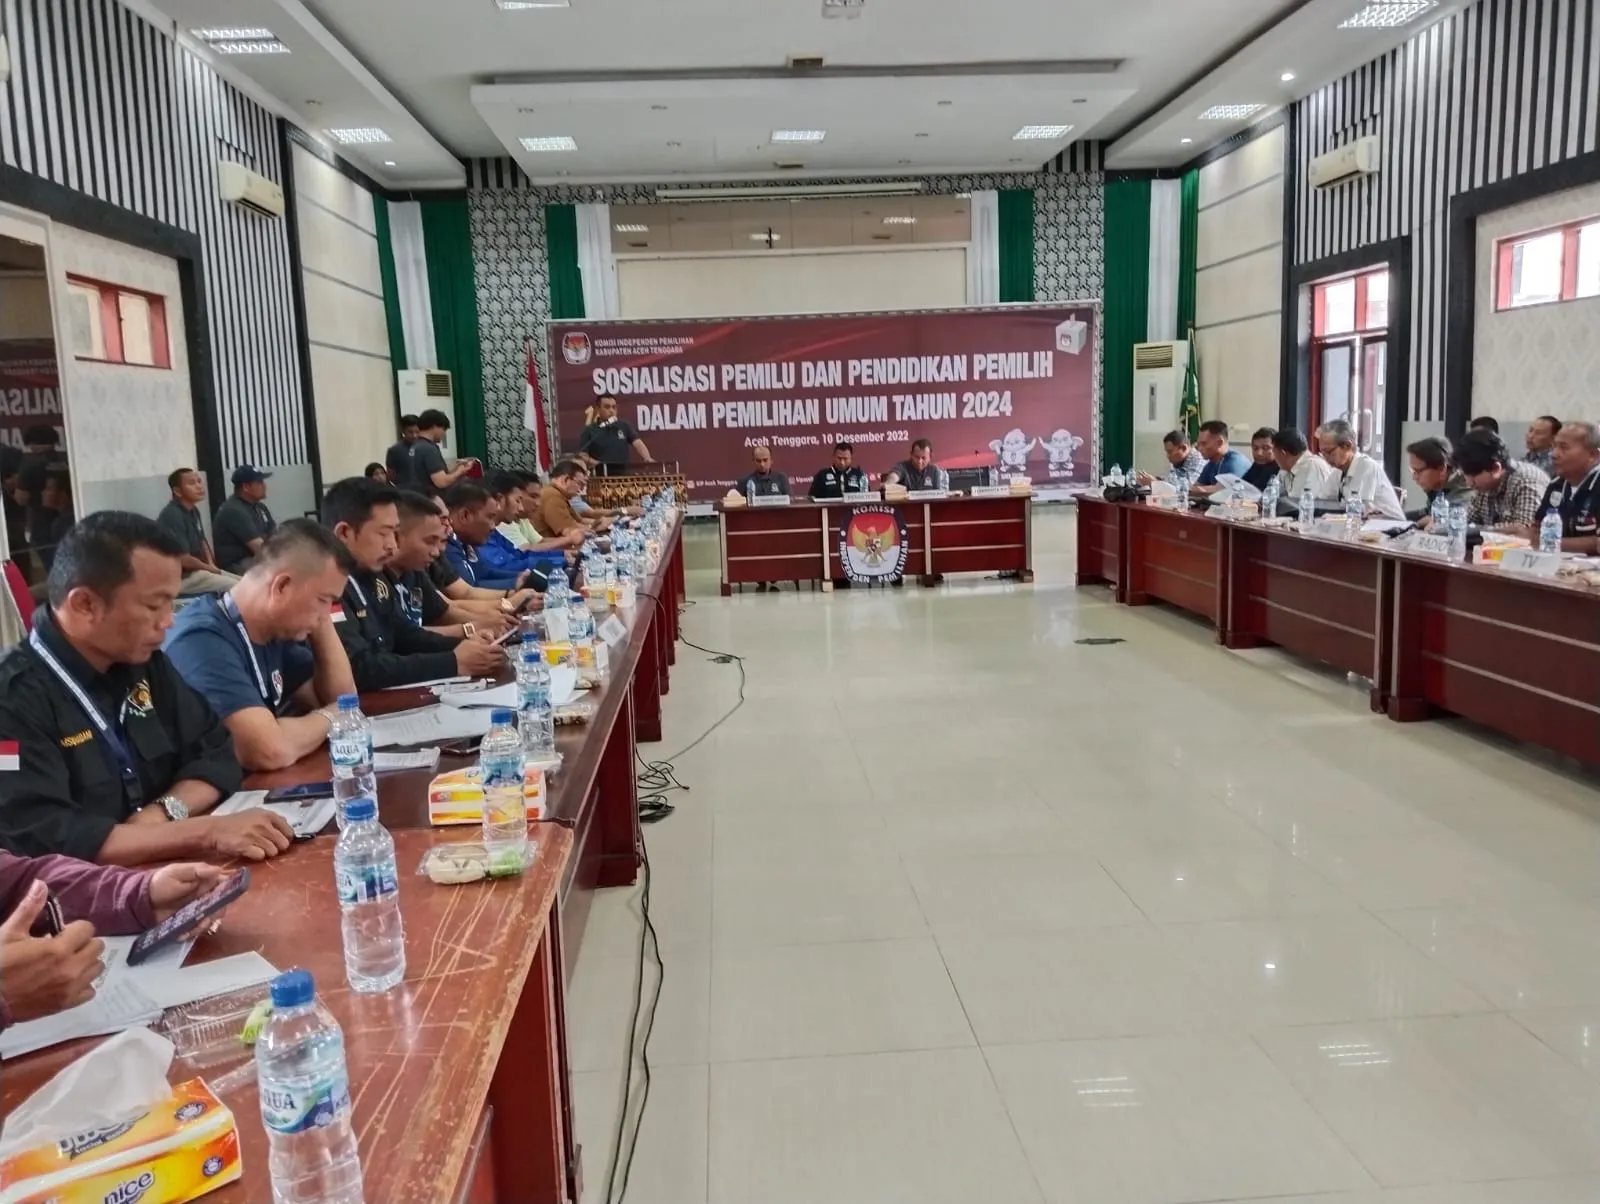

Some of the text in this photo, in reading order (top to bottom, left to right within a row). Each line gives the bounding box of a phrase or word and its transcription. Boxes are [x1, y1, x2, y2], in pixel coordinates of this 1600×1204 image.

[617, 337, 658, 346] INDEPENDEN
[660, 336, 694, 345] PEMILIHAN
[595, 346, 683, 355] KABUPATEN ACEH TENGGARA
[593, 351, 1053, 396] SOSIALISASI PEMILU DAN PENDIDIKAN PEMILIH
[637, 391, 1013, 431] DALAM PEMILIHAN UMUM TAHUN 2024
[744, 430, 909, 447] Aceh Tenggara, 10 Desember 2022
[852, 505, 895, 516] KOMISI
[878, 540, 908, 583] PEMILIHAN
[1521, 552, 1538, 568] TV
[333, 744, 360, 754] AQUA
[263, 1087, 297, 1113] QUA
[103, 1171, 154, 1204] nice
